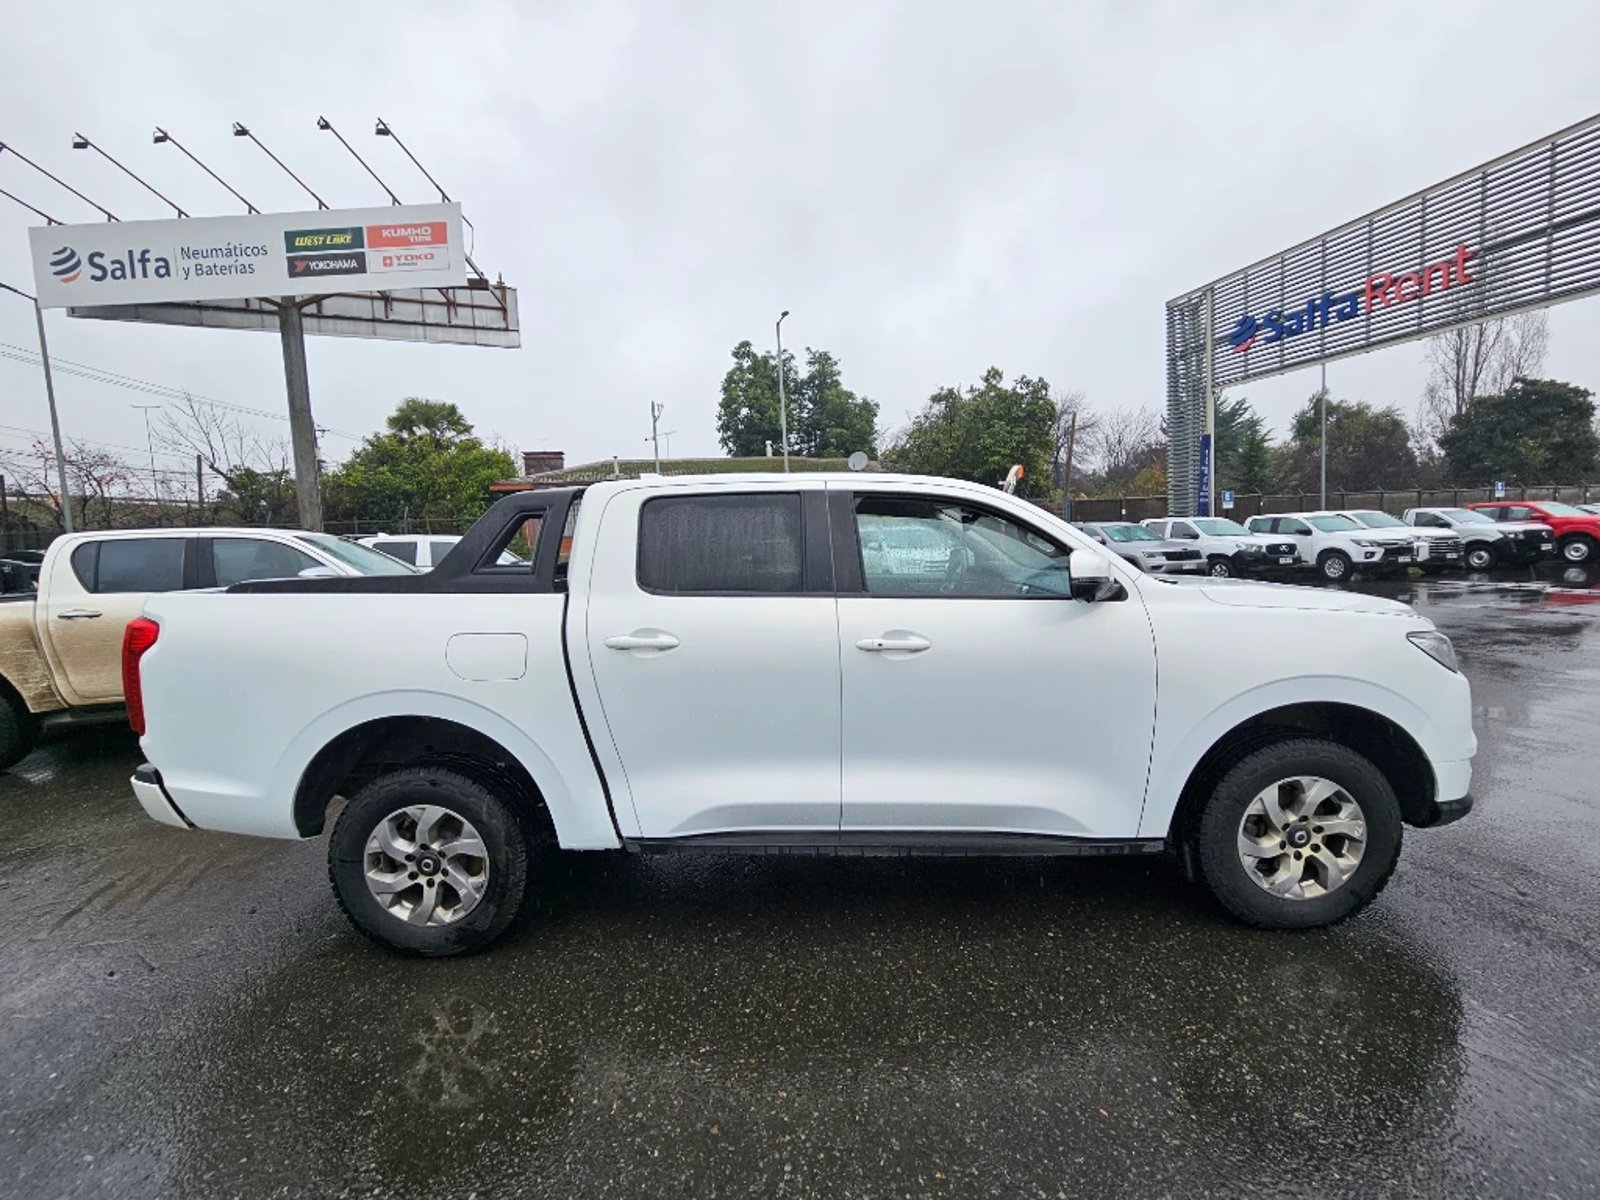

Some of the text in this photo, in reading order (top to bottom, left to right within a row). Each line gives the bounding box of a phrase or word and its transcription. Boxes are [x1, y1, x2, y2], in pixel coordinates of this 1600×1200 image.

[382, 226, 431, 238] KUMHO
[294, 237, 324, 246] WEST
[180, 242, 268, 260] Neumáticos
[394, 253, 434, 261] YOKO
[88, 249, 171, 282] Salfa
[183, 260, 256, 280] y Baterías
[308, 259, 358, 271] YOKOHAMA
